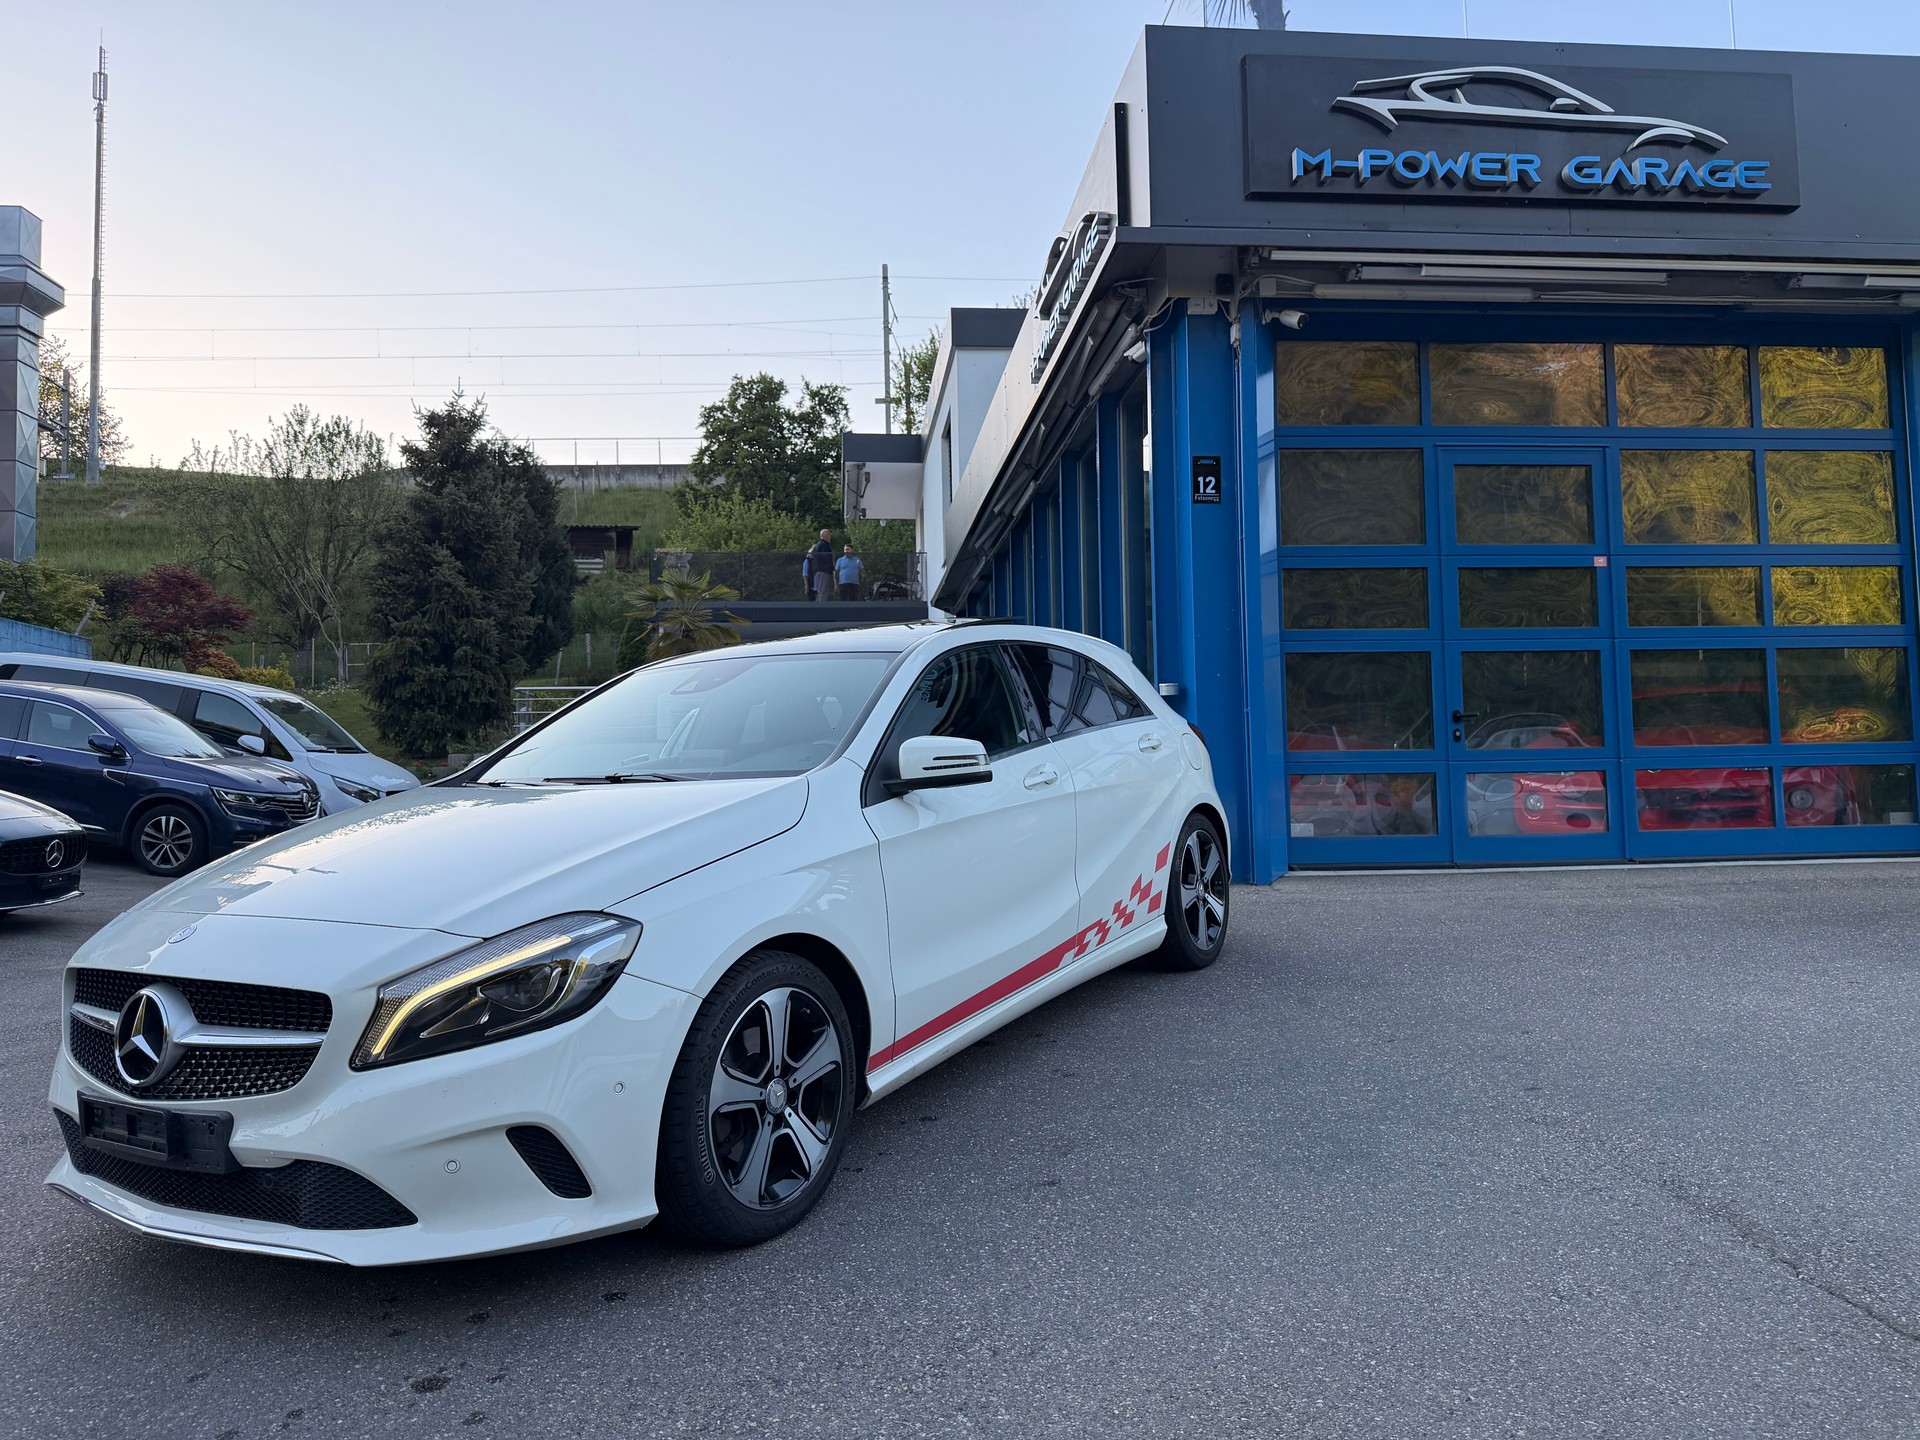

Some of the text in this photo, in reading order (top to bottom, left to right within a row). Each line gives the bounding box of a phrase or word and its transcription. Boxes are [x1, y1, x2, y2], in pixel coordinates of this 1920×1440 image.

[1293, 147, 1771, 190] M-POWER GARAGE
[1062, 211, 1099, 310] GARAGE
[1197, 476, 1216, 494] 12
[711, 965, 780, 1039] PremiumContact
[694, 1107, 716, 1186] Continental
